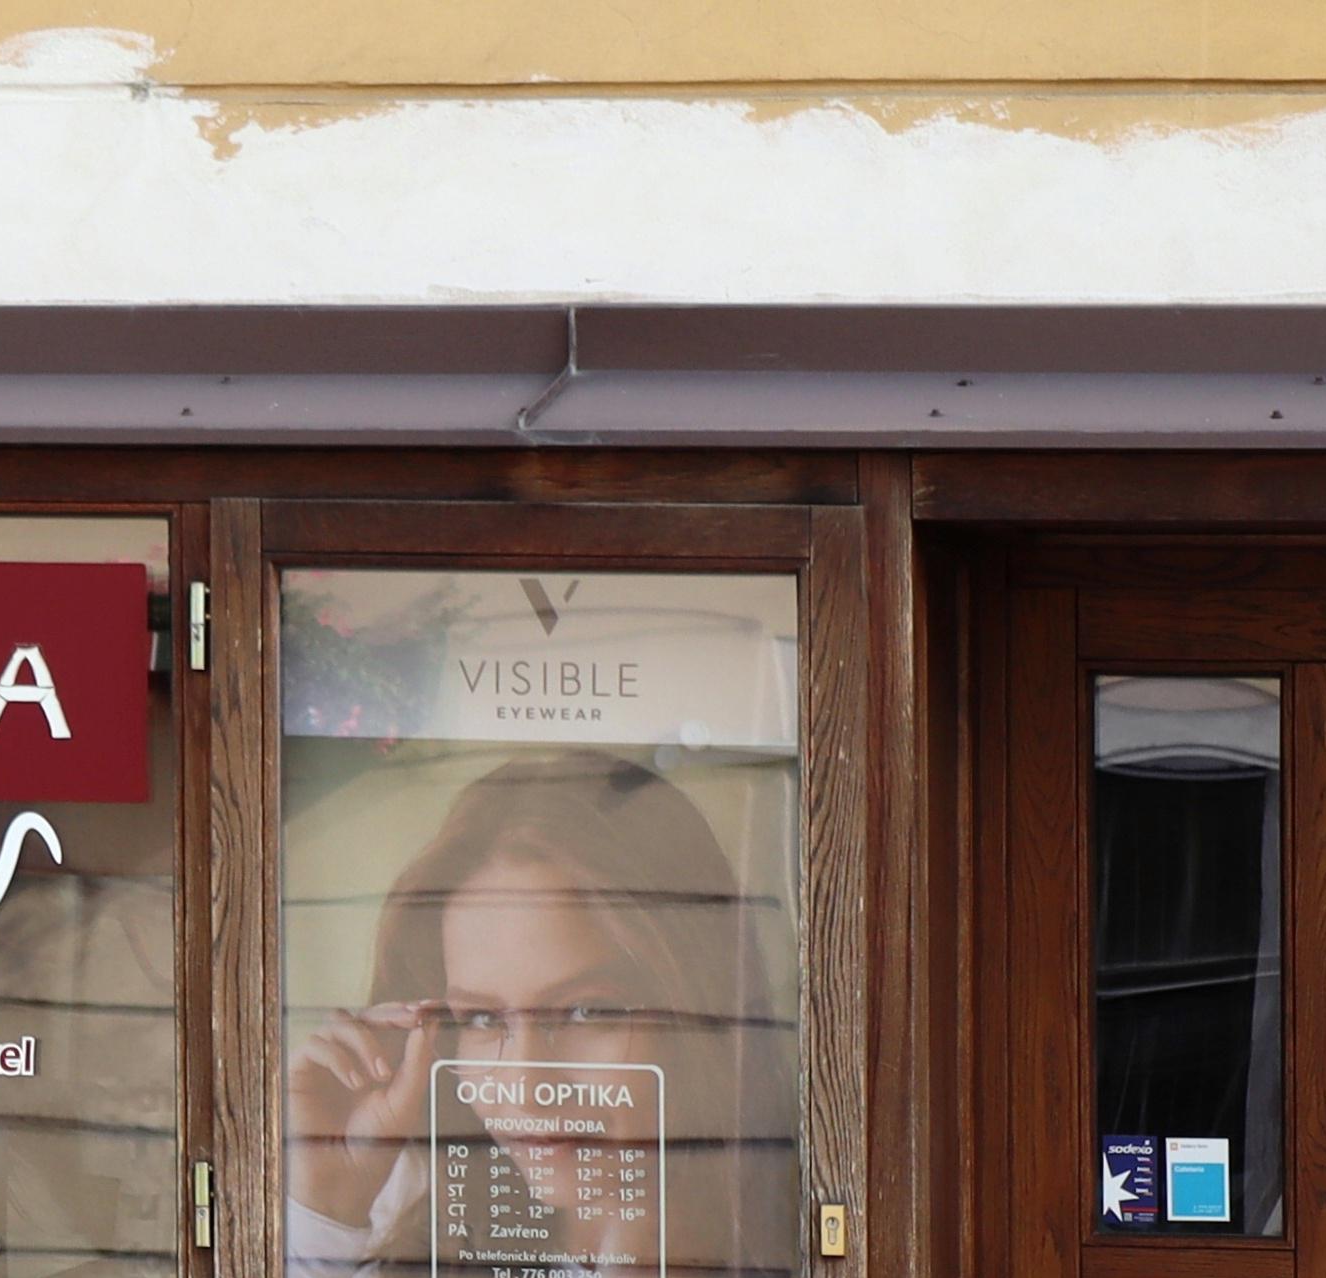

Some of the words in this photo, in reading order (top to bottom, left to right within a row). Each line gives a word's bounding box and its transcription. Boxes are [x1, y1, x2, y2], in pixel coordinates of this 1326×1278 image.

[459, 660, 639, 698] VISIBLE
[497, 706, 602, 721] EYEWEAR
[457, 1075, 526, 1104] OČNÍ
[534, 1083, 634, 1107] OPTIKA
[484, 1116, 560, 1132] PROVOZNÍ
[564, 1120, 606, 1133] DOBA
[448, 1145, 469, 1158] PO
[1107, 1141, 1153, 1155] sodexo
[448, 1162, 467, 1178] ÚT
[448, 1184, 465, 1197] ST
[448, 1198, 467, 1216] ČT
[448, 1220, 467, 1236] PÁ
[490, 1224, 549, 1239] Zavřeno
[459, 1250, 473, 1260] Po
[476, 1250, 536, 1262] telefonické
[539, 1249, 587, 1263] domluvě
[590, 1252, 636, 1266] kdykoliv
